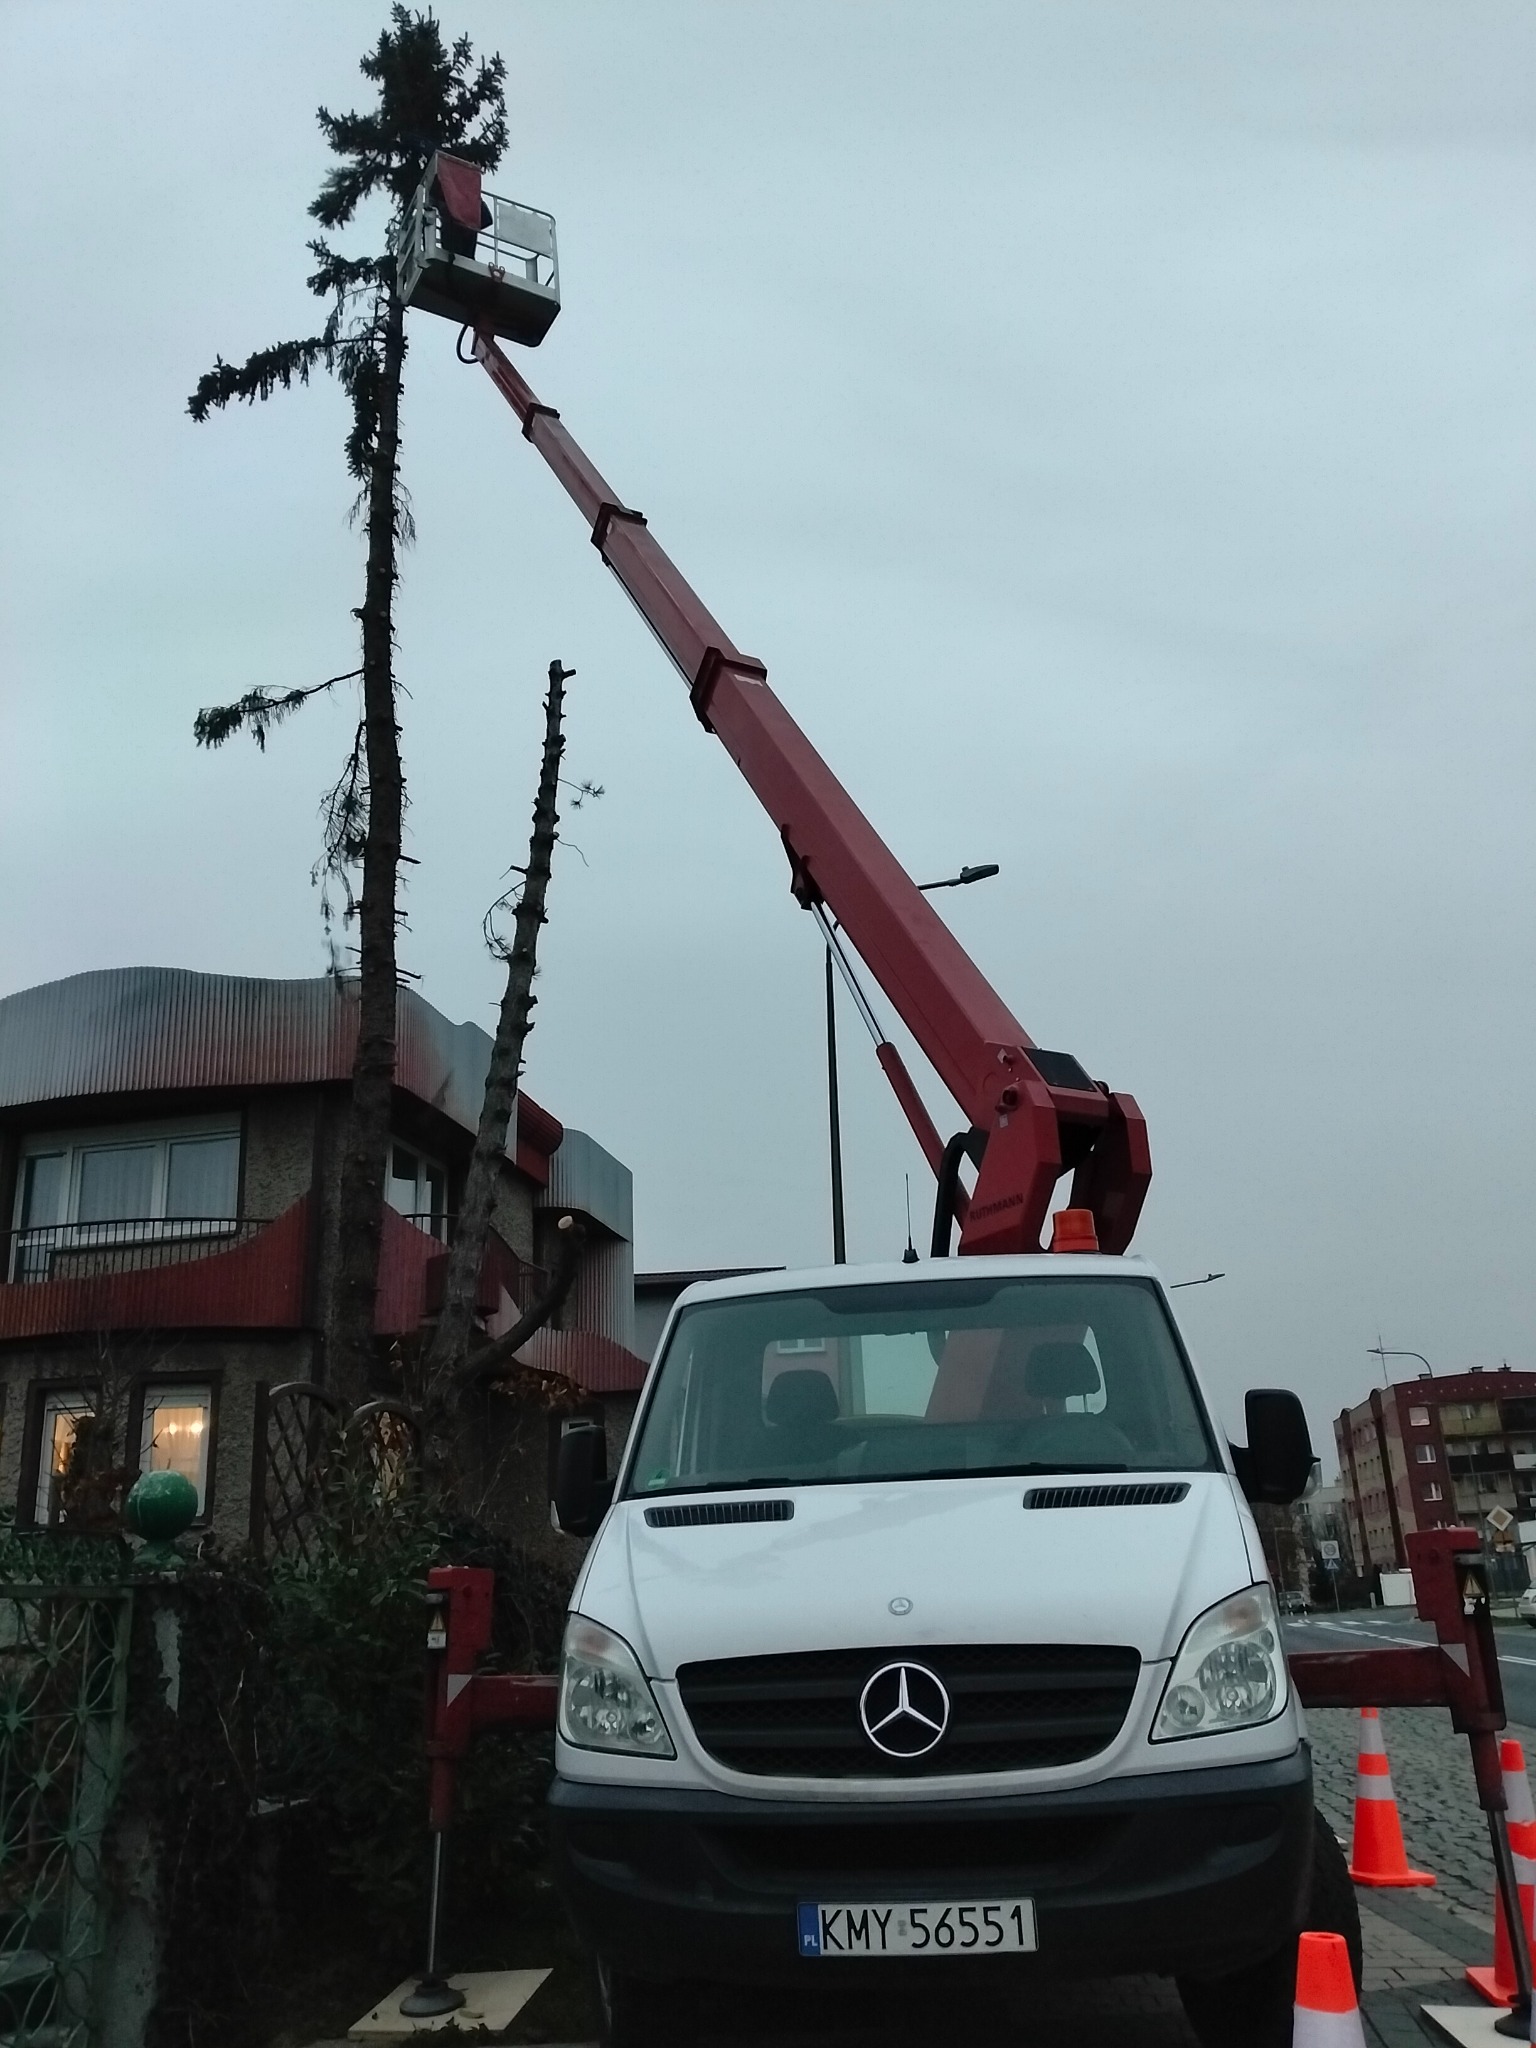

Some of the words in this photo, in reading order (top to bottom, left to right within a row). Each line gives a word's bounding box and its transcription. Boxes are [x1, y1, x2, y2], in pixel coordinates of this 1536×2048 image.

[970, 1193, 1024, 1222] RUTHMANN
[804, 1935, 818, 1946] PL
[821, 1908, 893, 1950] KMY
[909, 1905, 1024, 1949] 56551
